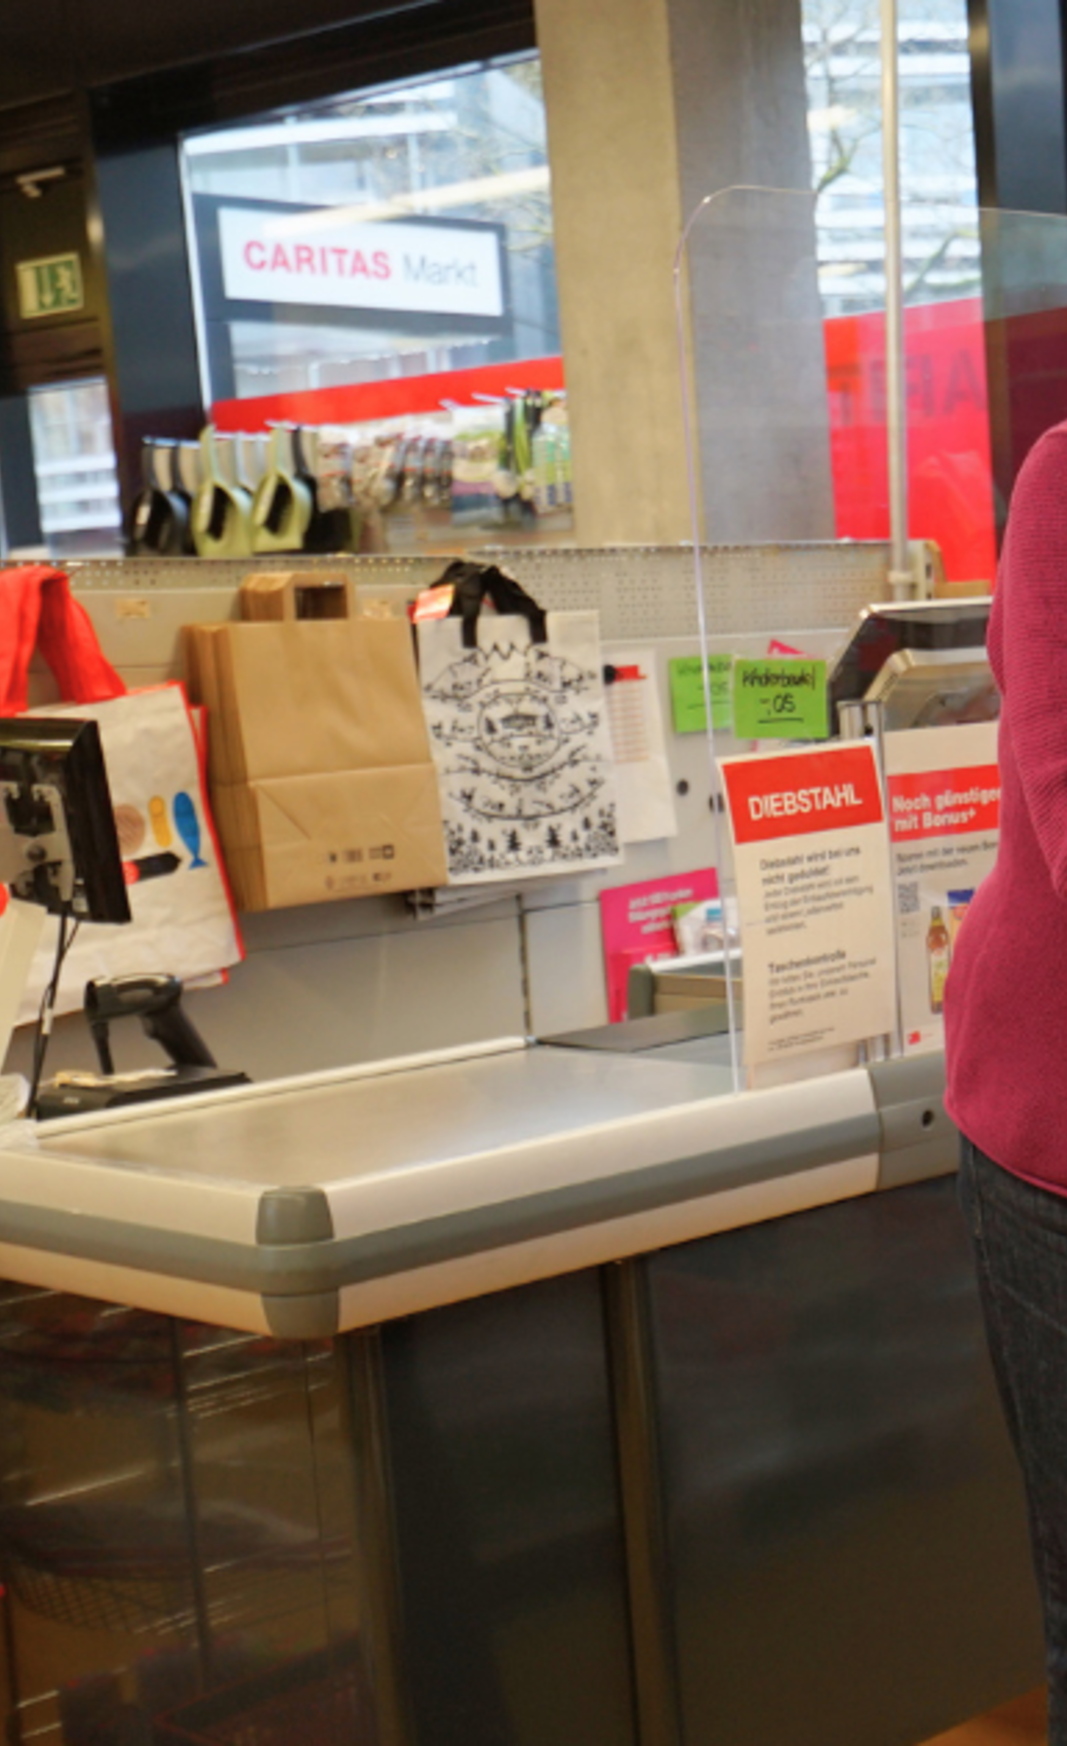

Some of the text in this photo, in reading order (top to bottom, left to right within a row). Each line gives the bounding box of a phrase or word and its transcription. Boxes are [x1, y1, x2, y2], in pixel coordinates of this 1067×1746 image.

[244, 239, 479, 289] CARITAS Markt
[748, 783, 863, 821] DIEBSTAHL
[892, 792, 931, 812] Noch
[894, 815, 918, 832] mit
